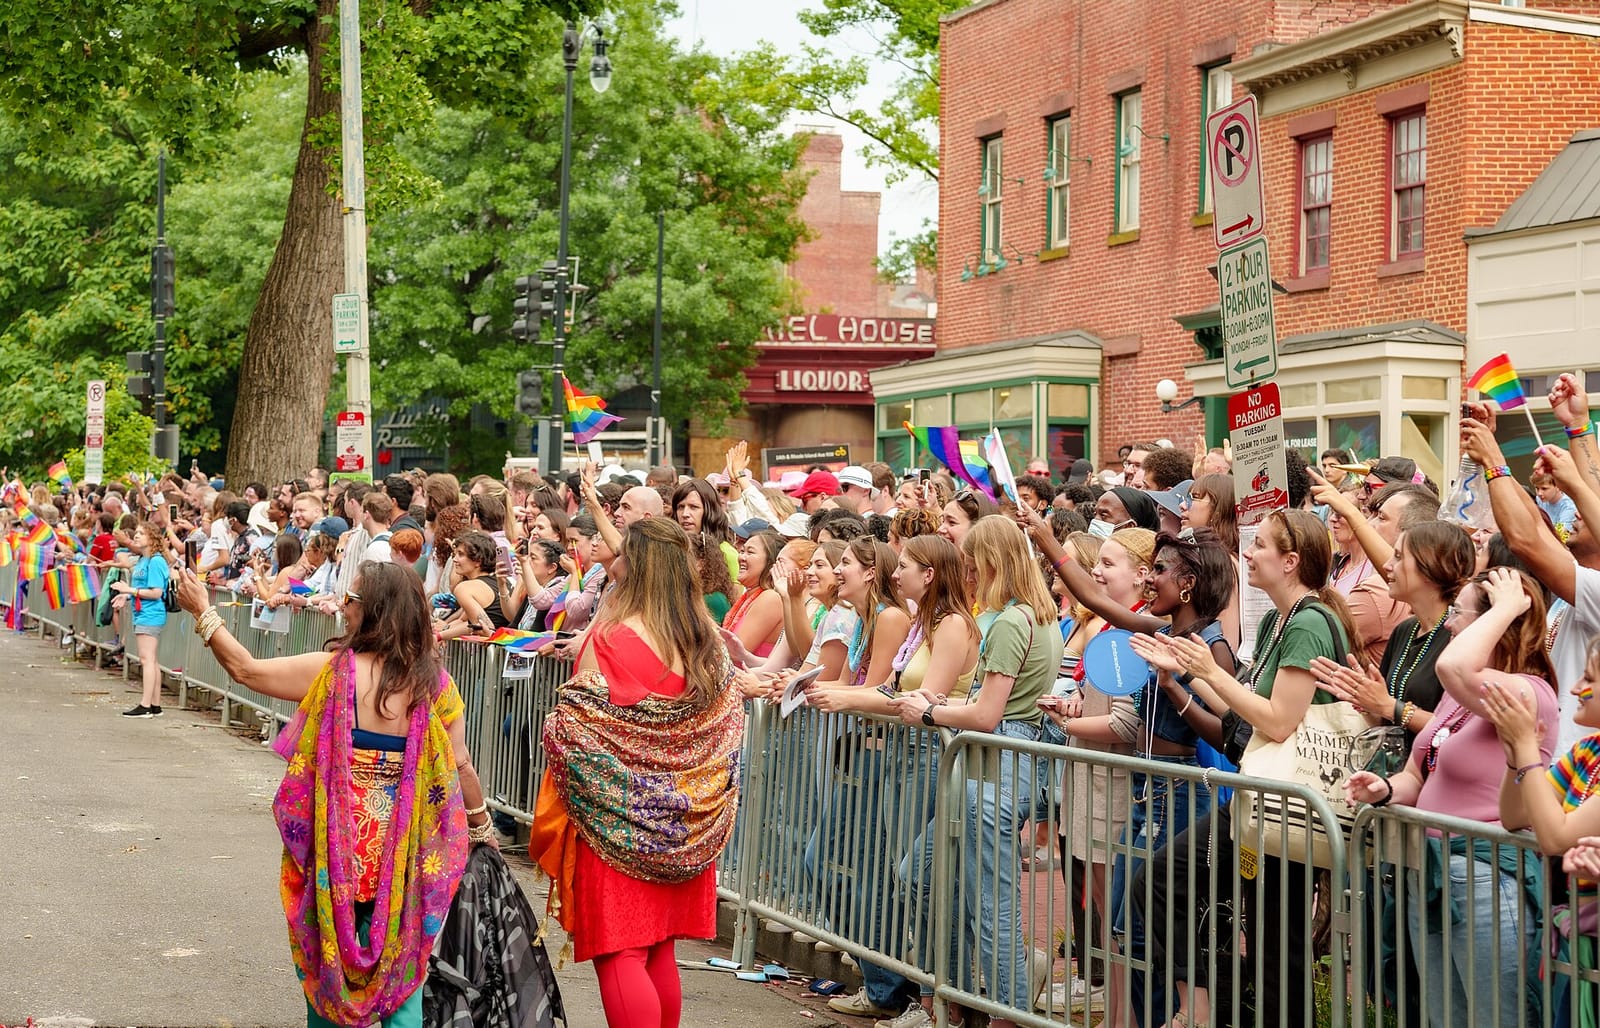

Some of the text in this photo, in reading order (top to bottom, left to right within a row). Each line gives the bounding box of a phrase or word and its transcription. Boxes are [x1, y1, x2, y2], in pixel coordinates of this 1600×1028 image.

[1225, 250, 1264, 288] 2 HOUR
[1225, 281, 1268, 319] PARKING
[838, 317, 933, 343] HOUSE
[1231, 333, 1269, 355] MONDAY-FRIDAY
[780, 370, 863, 391] LIQUOR
[1247, 392, 1262, 408] NO
[1235, 403, 1276, 427] PARKING
[1244, 424, 1267, 437] TUESDAY
[1253, 439, 1259, 447] TO
[1291, 439, 1300, 448] FOR
[1301, 437, 1317, 447] LEASE
